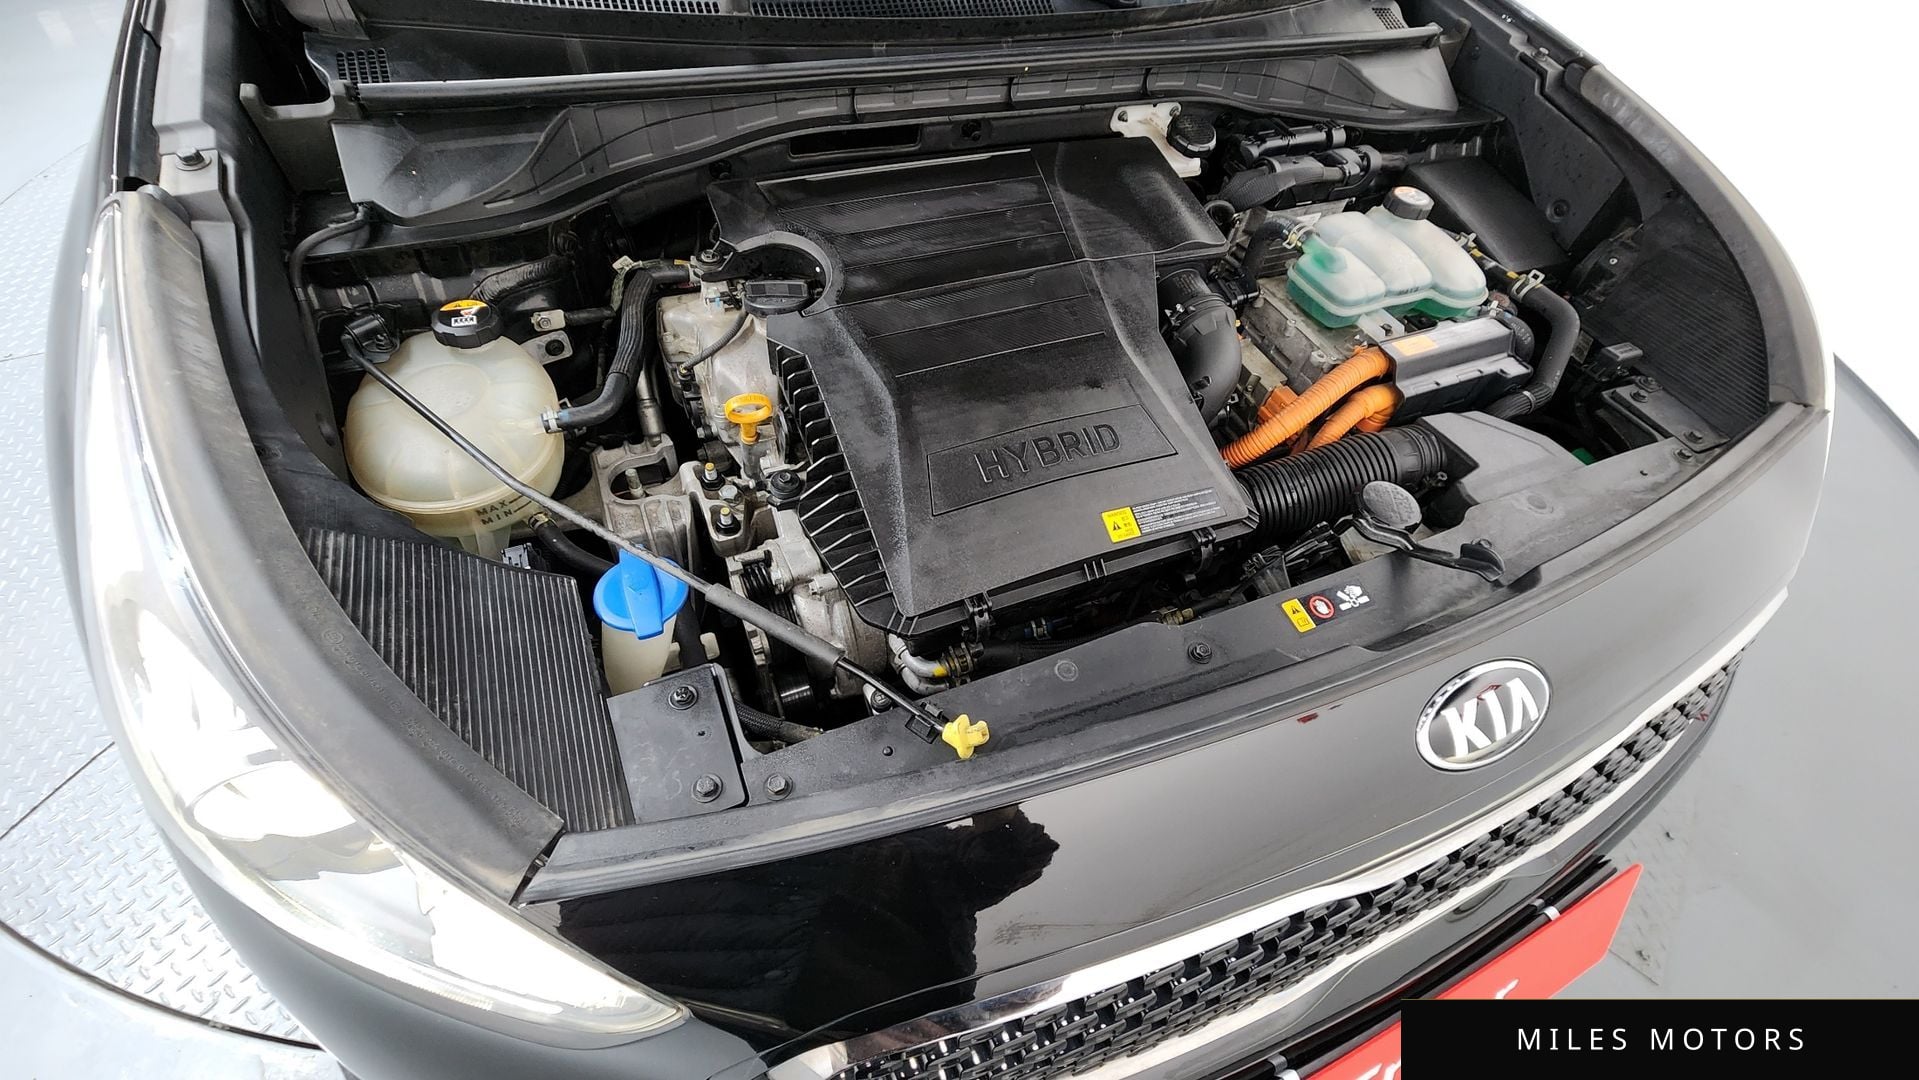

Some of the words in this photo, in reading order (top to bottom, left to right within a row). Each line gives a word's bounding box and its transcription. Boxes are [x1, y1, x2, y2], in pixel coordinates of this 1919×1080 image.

[974, 424, 1121, 483] HYBRID
[475, 500, 508, 516] MAX
[481, 509, 513, 525] MIN
[1440, 677, 1539, 758] KIA
